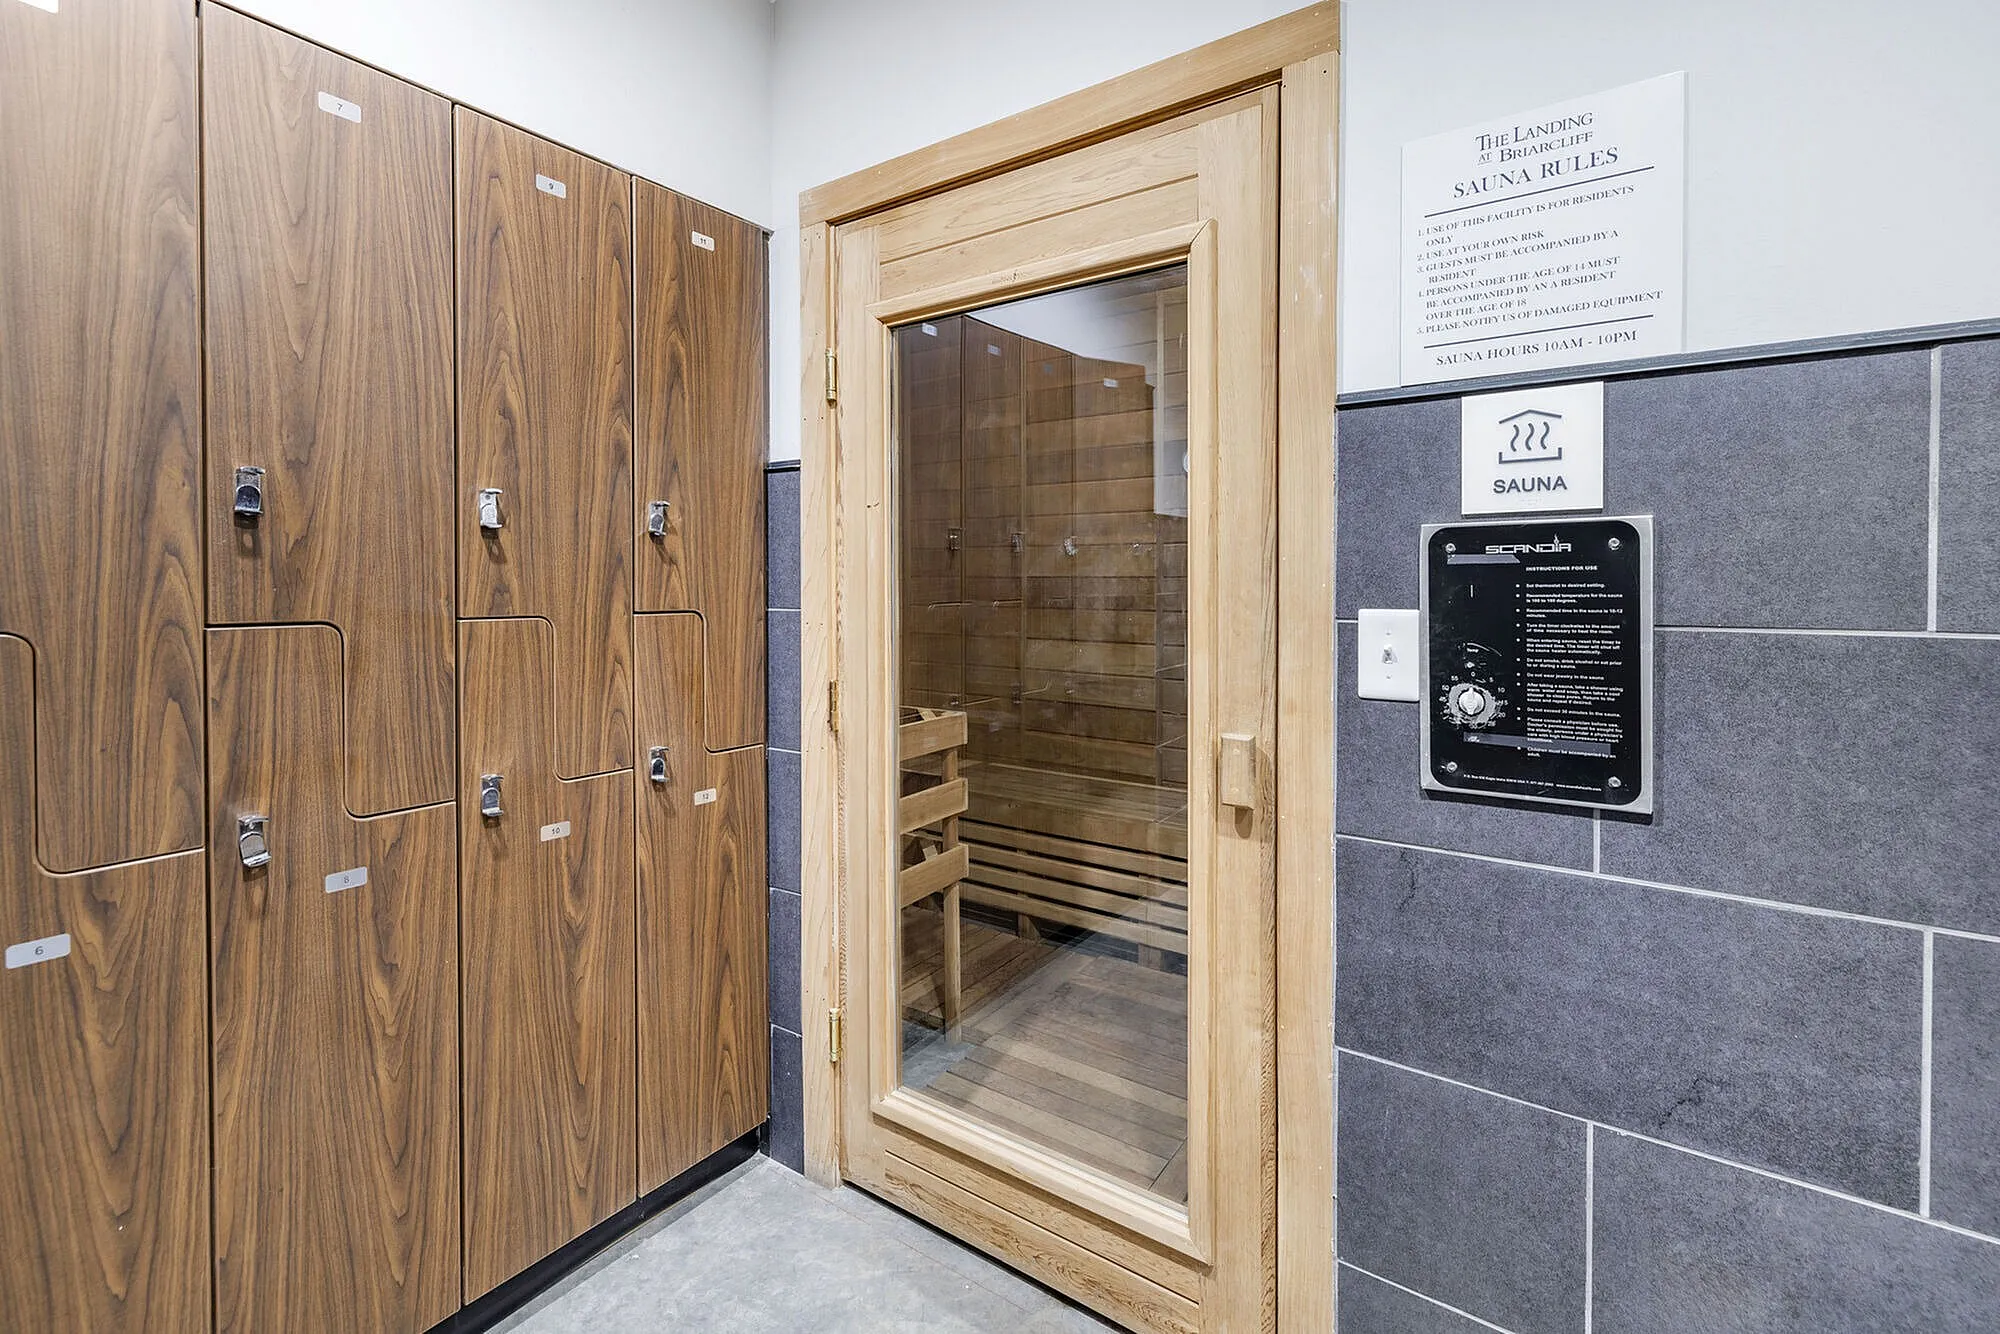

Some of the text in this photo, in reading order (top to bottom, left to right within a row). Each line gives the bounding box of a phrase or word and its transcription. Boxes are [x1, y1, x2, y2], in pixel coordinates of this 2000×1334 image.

[337, 103, 342, 111] 7
[1475, 112, 1593, 151] THE LANDING
[1477, 131, 1593, 163] AT BRIARCLIFF
[1453, 146, 1619, 199] SAUNA RULES
[1426, 225, 1444, 234] USE
[1446, 222, 1459, 231] OF
[1463, 217, 1485, 228] THIS
[1487, 206, 1534, 222] FACILITY
[1536, 204, 1546, 212] IS
[1548, 199, 1570, 210] FOR
[1572, 185, 1635, 205] RESIDENTS
[1426, 235, 1453, 247] ONLY
[1426, 250, 1444, 259] USE
[1446, 247, 1459, 256] AT
[1461, 240, 1490, 252] YOUR
[1492, 235, 1518, 247] OWN
[1521, 229, 1544, 241] RISK
[1426, 259, 1462, 272] GUESTS
[1465, 253, 1491, 264] MUST
[1495, 250, 1508, 259] BE
[1511, 235, 1590, 256] ACCOMPANIED
[1593, 231, 1608, 241] BY
[1609, 230, 1619, 238] A
[1426, 283, 1468, 296] PERSONS
[1470, 276, 1506, 288] UNDER
[1509, 272, 1530, 282] THE
[1532, 268, 1554, 278] AGE
[1557, 264, 1573, 274] OF
[1587, 256, 1620, 268] MUST
[1426, 300, 1439, 308] BE
[1442, 288, 1514, 306] ACCOMPANIED
[1516, 285, 1529, 294] BY
[1532, 282, 1548, 291] AN
[1561, 271, 1616, 287] RESIDENT
[1428, 268, 1476, 284] RESIDENT
[1426, 311, 1452, 321] OVER
[1455, 307, 1474, 316] THE
[1478, 304, 1498, 312] AGE
[1500, 301, 1515, 309] OF
[1426, 322, 1460, 333] PLEASE
[1502, 314, 1515, 322] US
[1517, 311, 1532, 320] OF
[1534, 302, 1590, 317] DAMAGED
[1593, 291, 1663, 309] EQUIPMENT
[1437, 352, 1483, 366] SAUNA
[1487, 343, 1539, 359] HOURS
[1545, 337, 1584, 352] 10AM
[1599, 330, 1637, 345] 10PM
[1493, 475, 1567, 494] SAUNA
[344, 875, 350, 884] 8
[35, 946, 43, 955] 6
